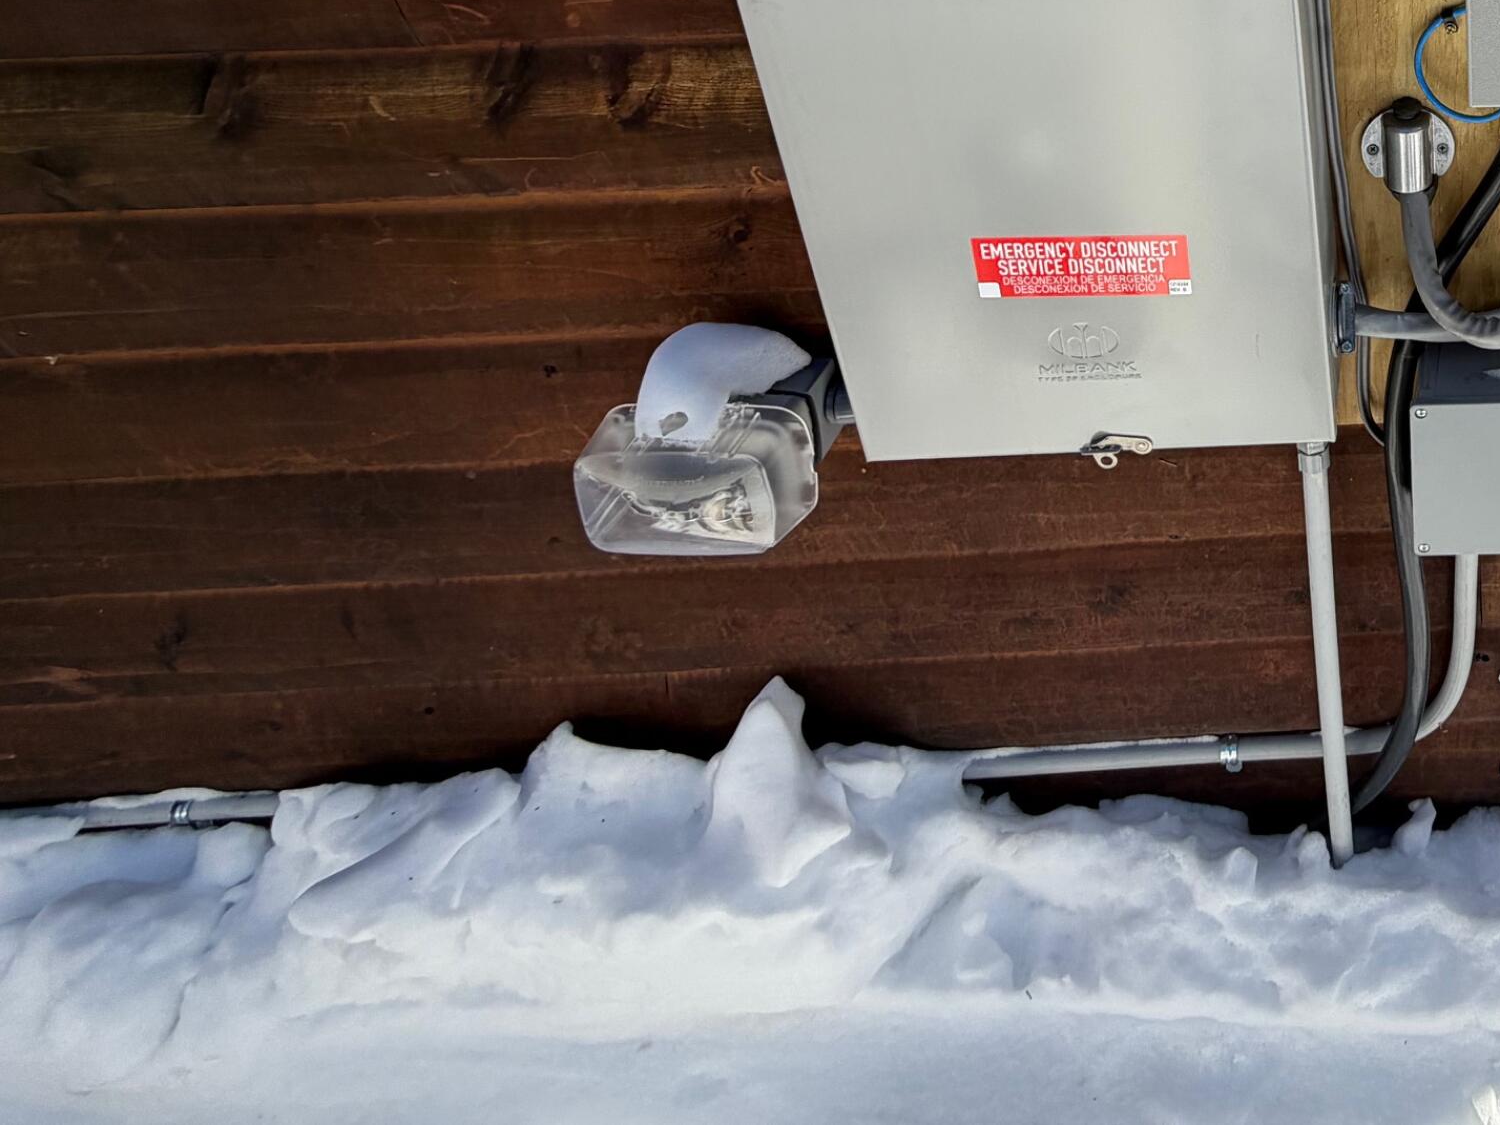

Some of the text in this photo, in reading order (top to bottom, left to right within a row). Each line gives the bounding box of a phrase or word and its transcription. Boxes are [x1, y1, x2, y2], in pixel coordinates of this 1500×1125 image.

[980, 240, 1178, 260] EMERGENCY DISCONNECT
[998, 257, 1166, 276] SERVICE DISCONNECT
[1080, 275, 1094, 285] DE
[1097, 274, 1165, 284] EMERGENCIA
[1091, 284, 1104, 294] DE
[1107, 284, 1156, 293] SERVICIO
[1038, 361, 1136, 374] MILBANK
